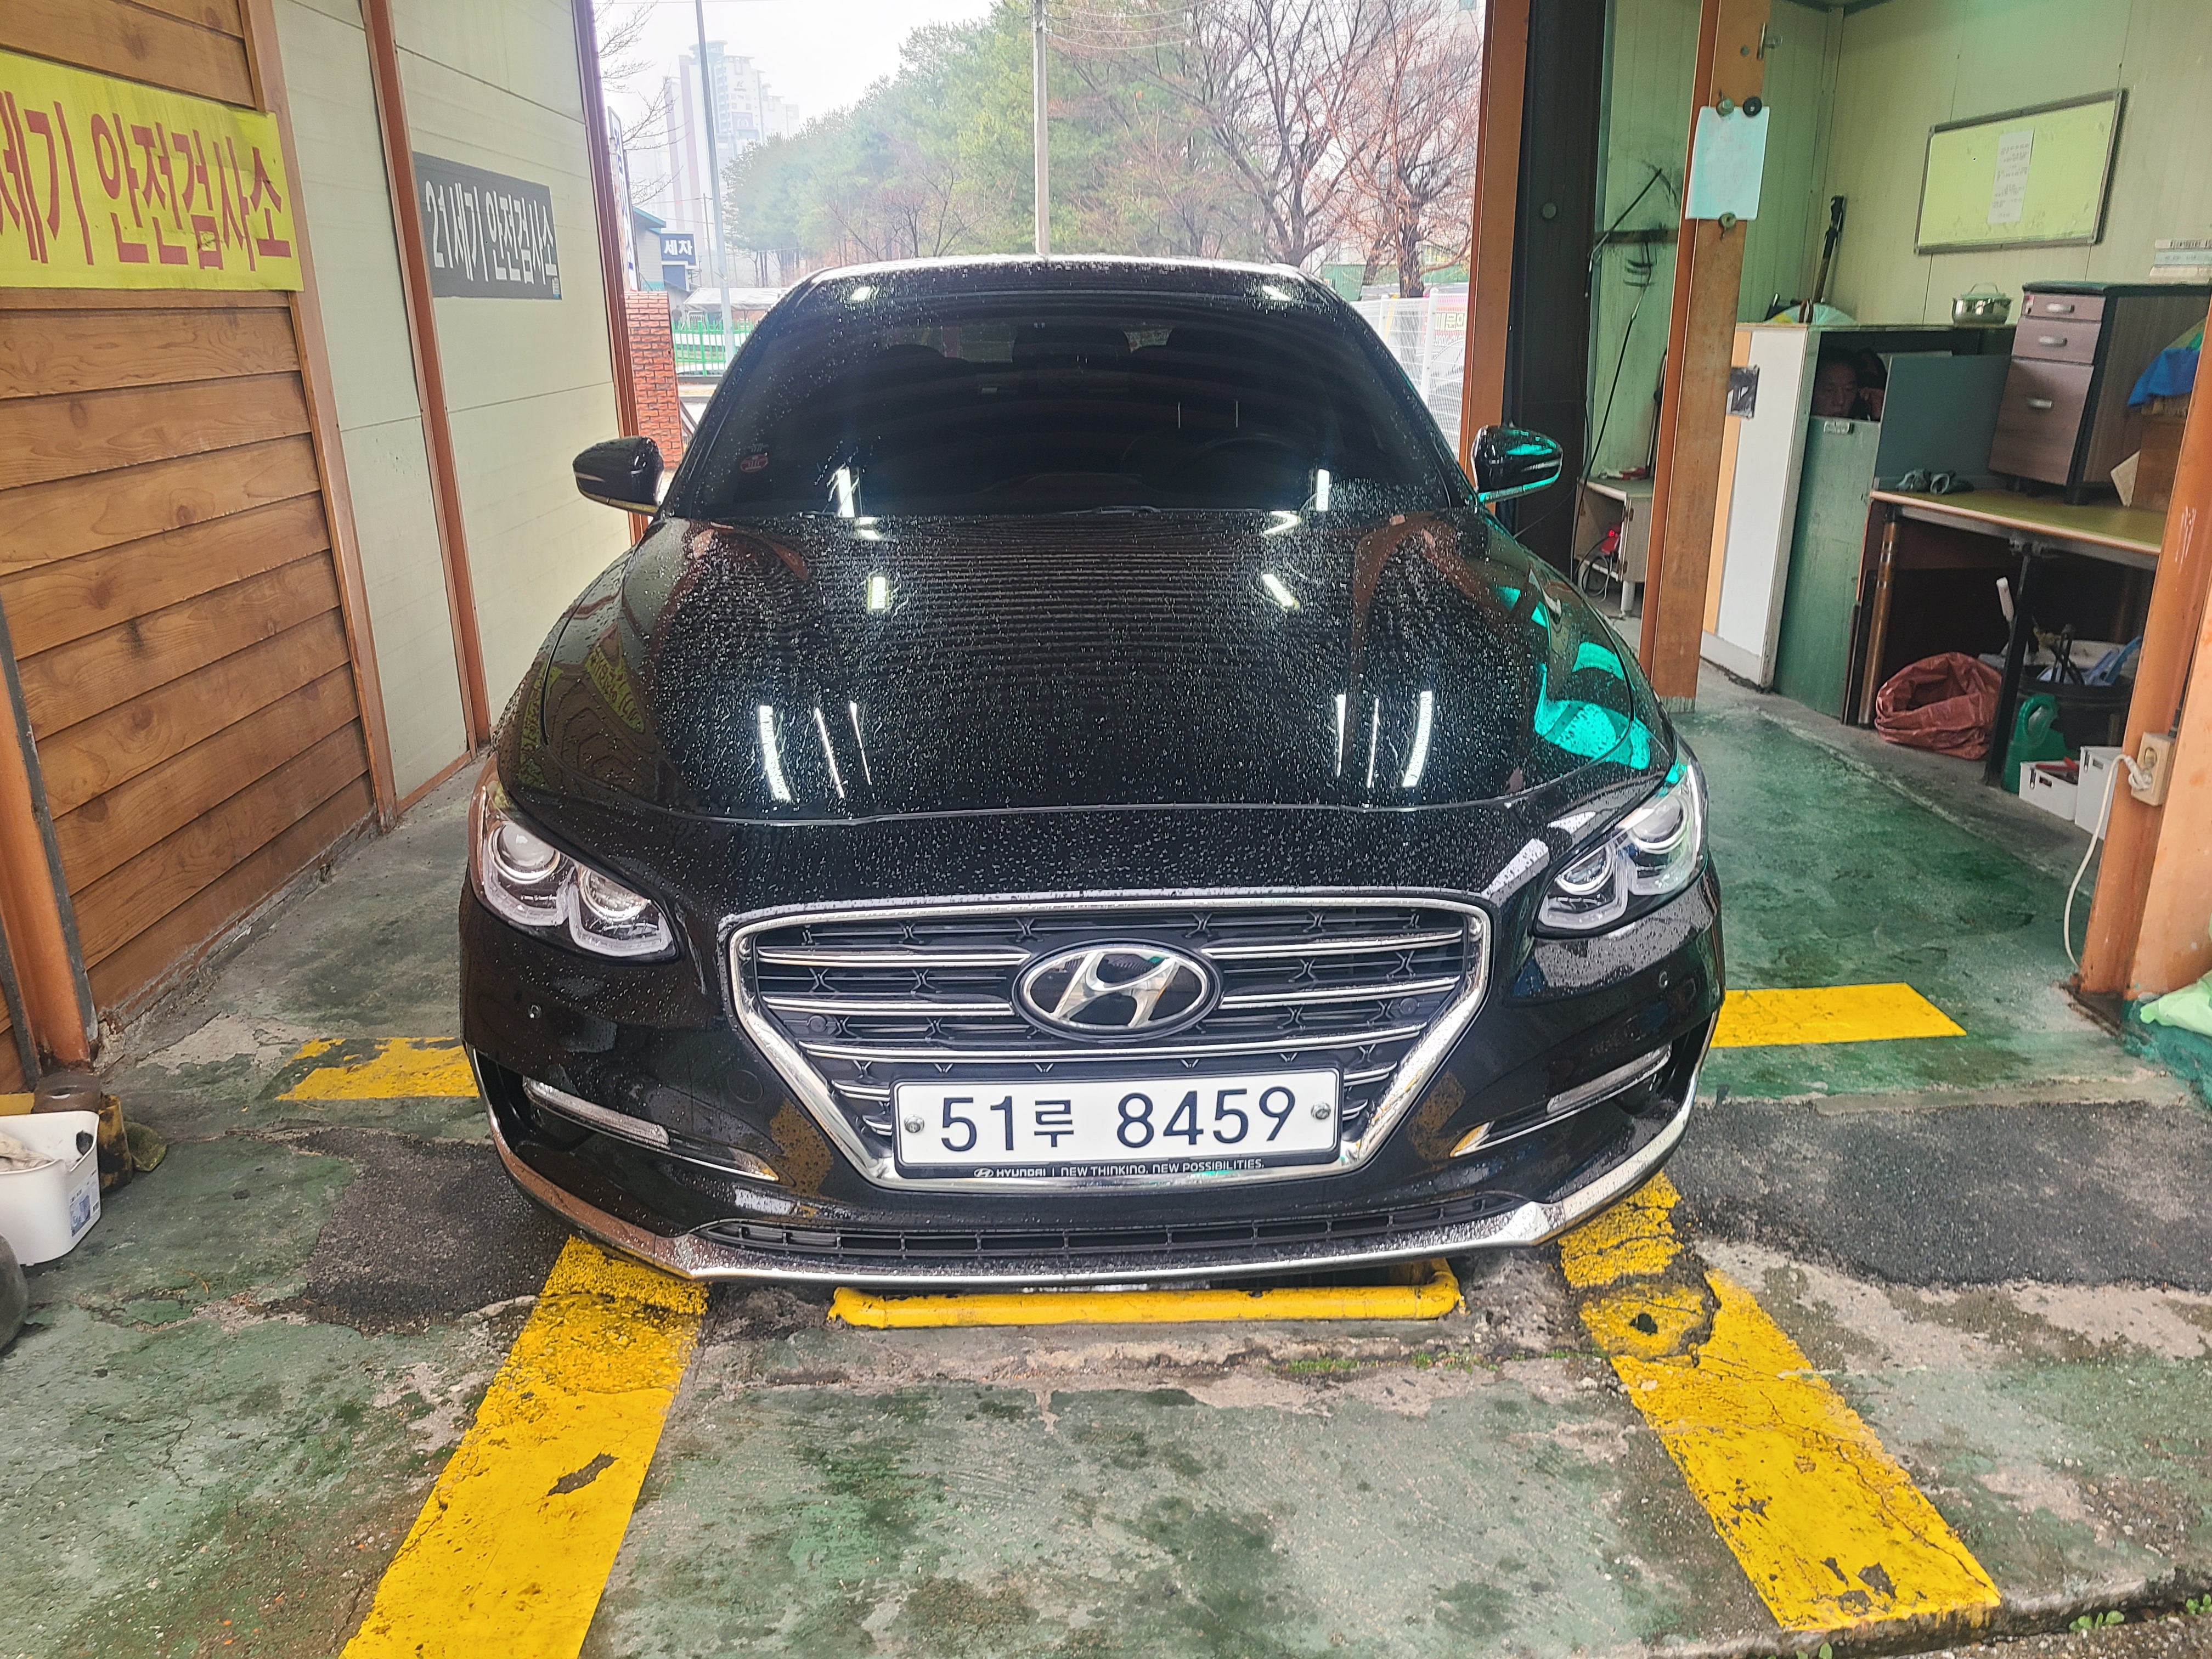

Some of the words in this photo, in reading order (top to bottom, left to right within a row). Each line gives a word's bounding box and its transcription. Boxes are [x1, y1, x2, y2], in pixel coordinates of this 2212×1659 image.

[90, 112, 292, 271] 안전검사소
[425, 180, 489, 282] 21세기
[486, 190, 557, 285] 안전검사소
[664, 240, 692, 256] 세차
[940, 1095, 1075, 1152] 51루
[1116, 1086, 1296, 1148] 8459
[996, 1167, 1046, 1177] HYUNDAI
[1060, 1166, 1088, 1177] NEW
[1152, 1162, 1180, 1175] NEW
